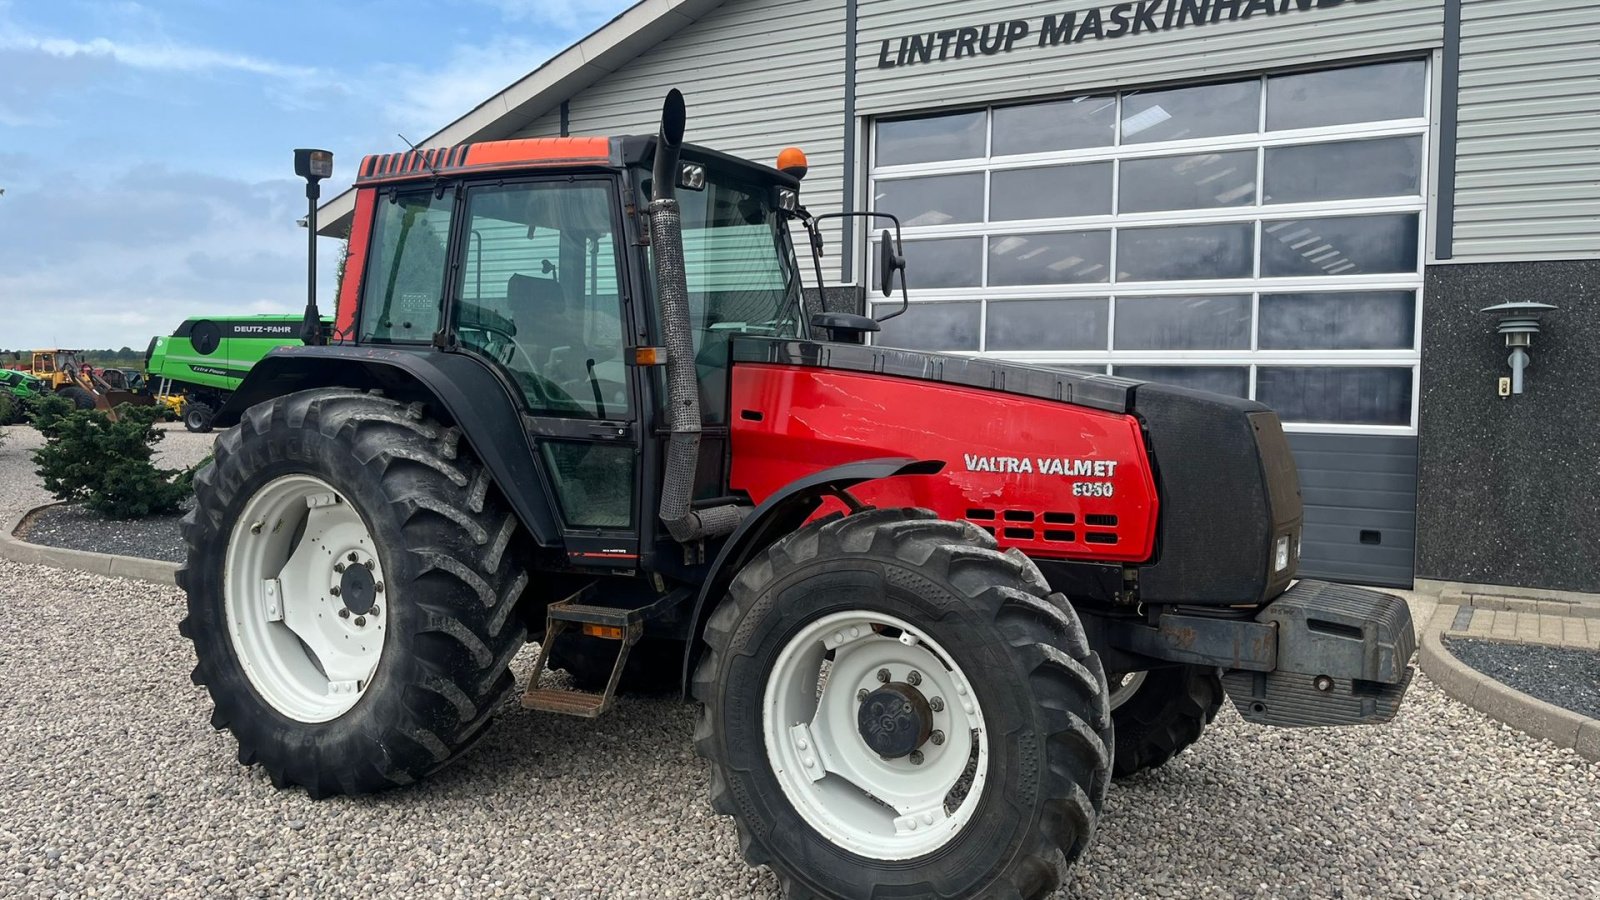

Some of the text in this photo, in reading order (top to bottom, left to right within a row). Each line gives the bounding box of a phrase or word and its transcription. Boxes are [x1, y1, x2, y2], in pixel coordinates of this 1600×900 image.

[878, 19, 1029, 69] LINTRUP
[964, 453, 1117, 477] VALTRA VALMET
